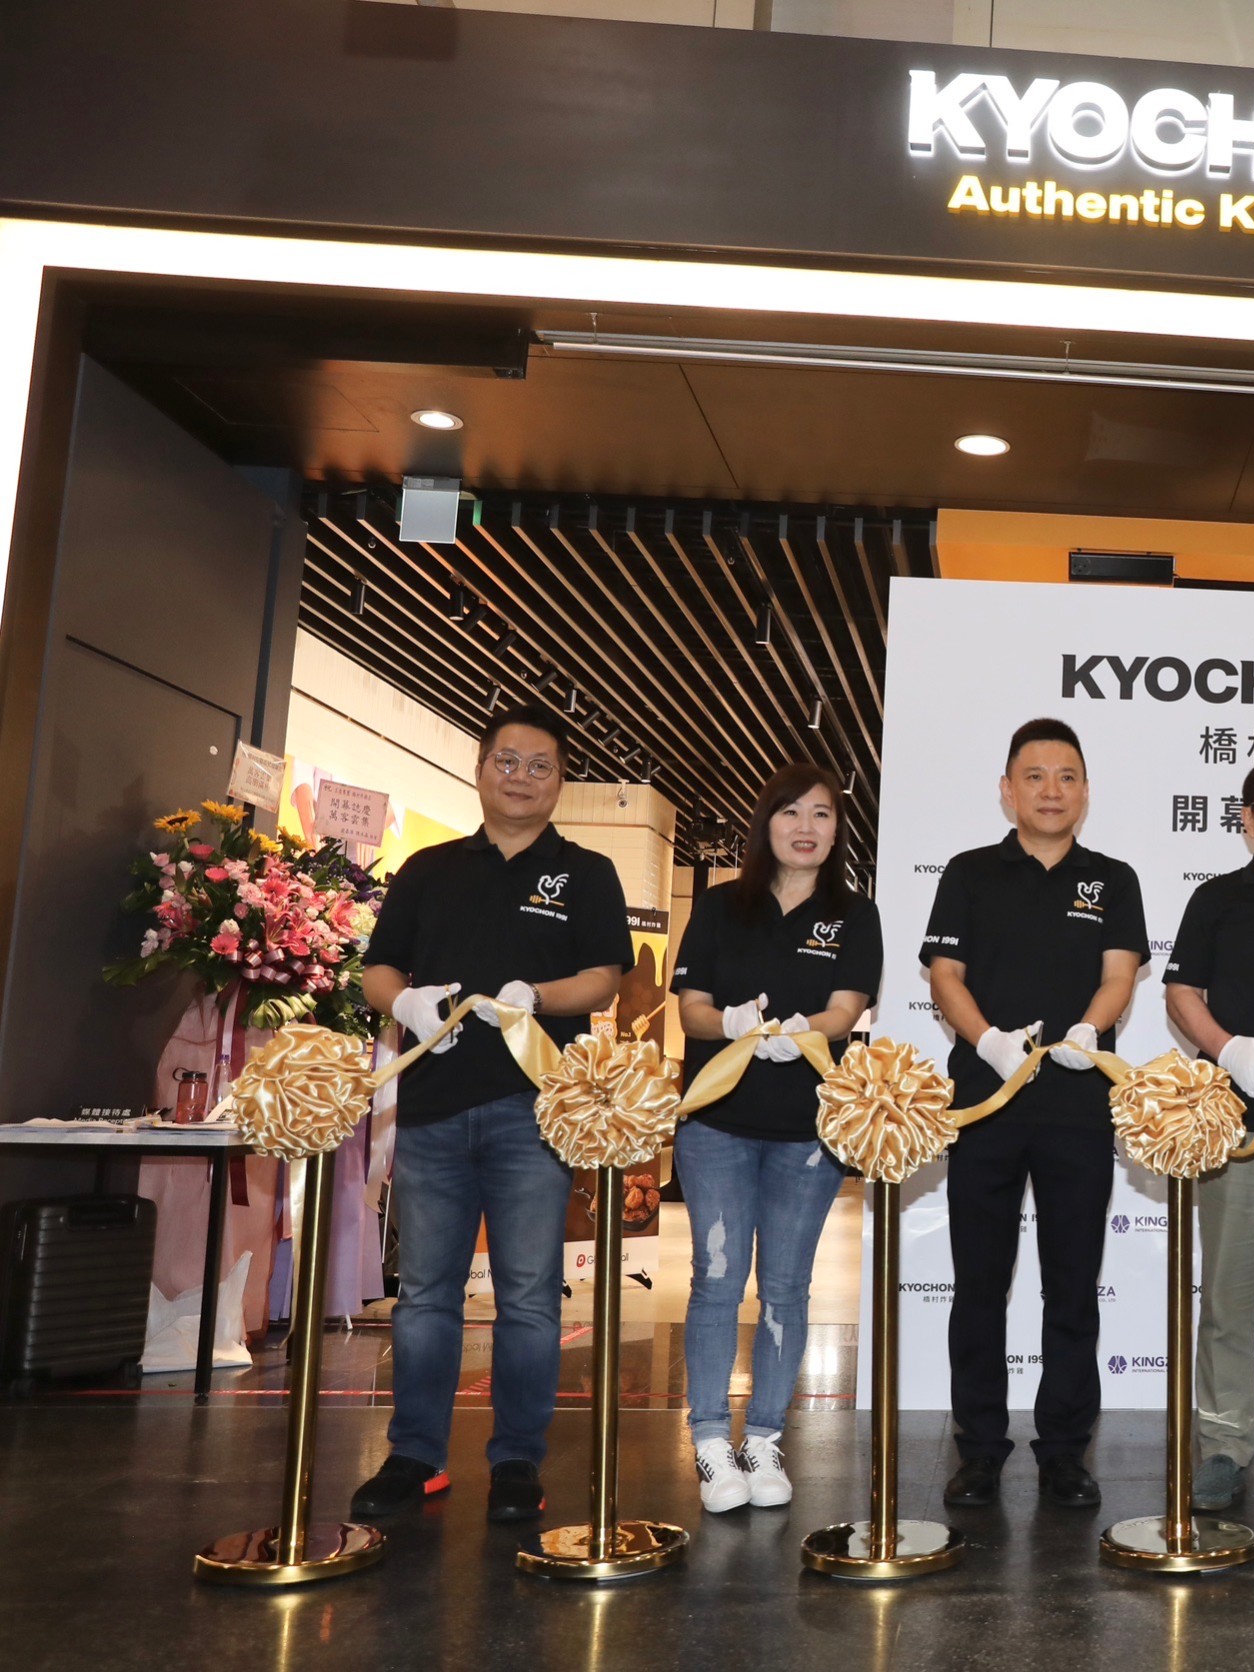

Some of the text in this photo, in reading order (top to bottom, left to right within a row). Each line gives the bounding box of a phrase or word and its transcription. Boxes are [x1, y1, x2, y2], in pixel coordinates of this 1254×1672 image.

[947, 174, 1206, 230] Authentic
[520, 905, 555, 917] KYOCHON
[941, 936, 959, 946] 1991
[1135, 1216, 1168, 1227] KING
[899, 1283, 955, 1292] KYOCHON
[1132, 1356, 1168, 1367] KING
